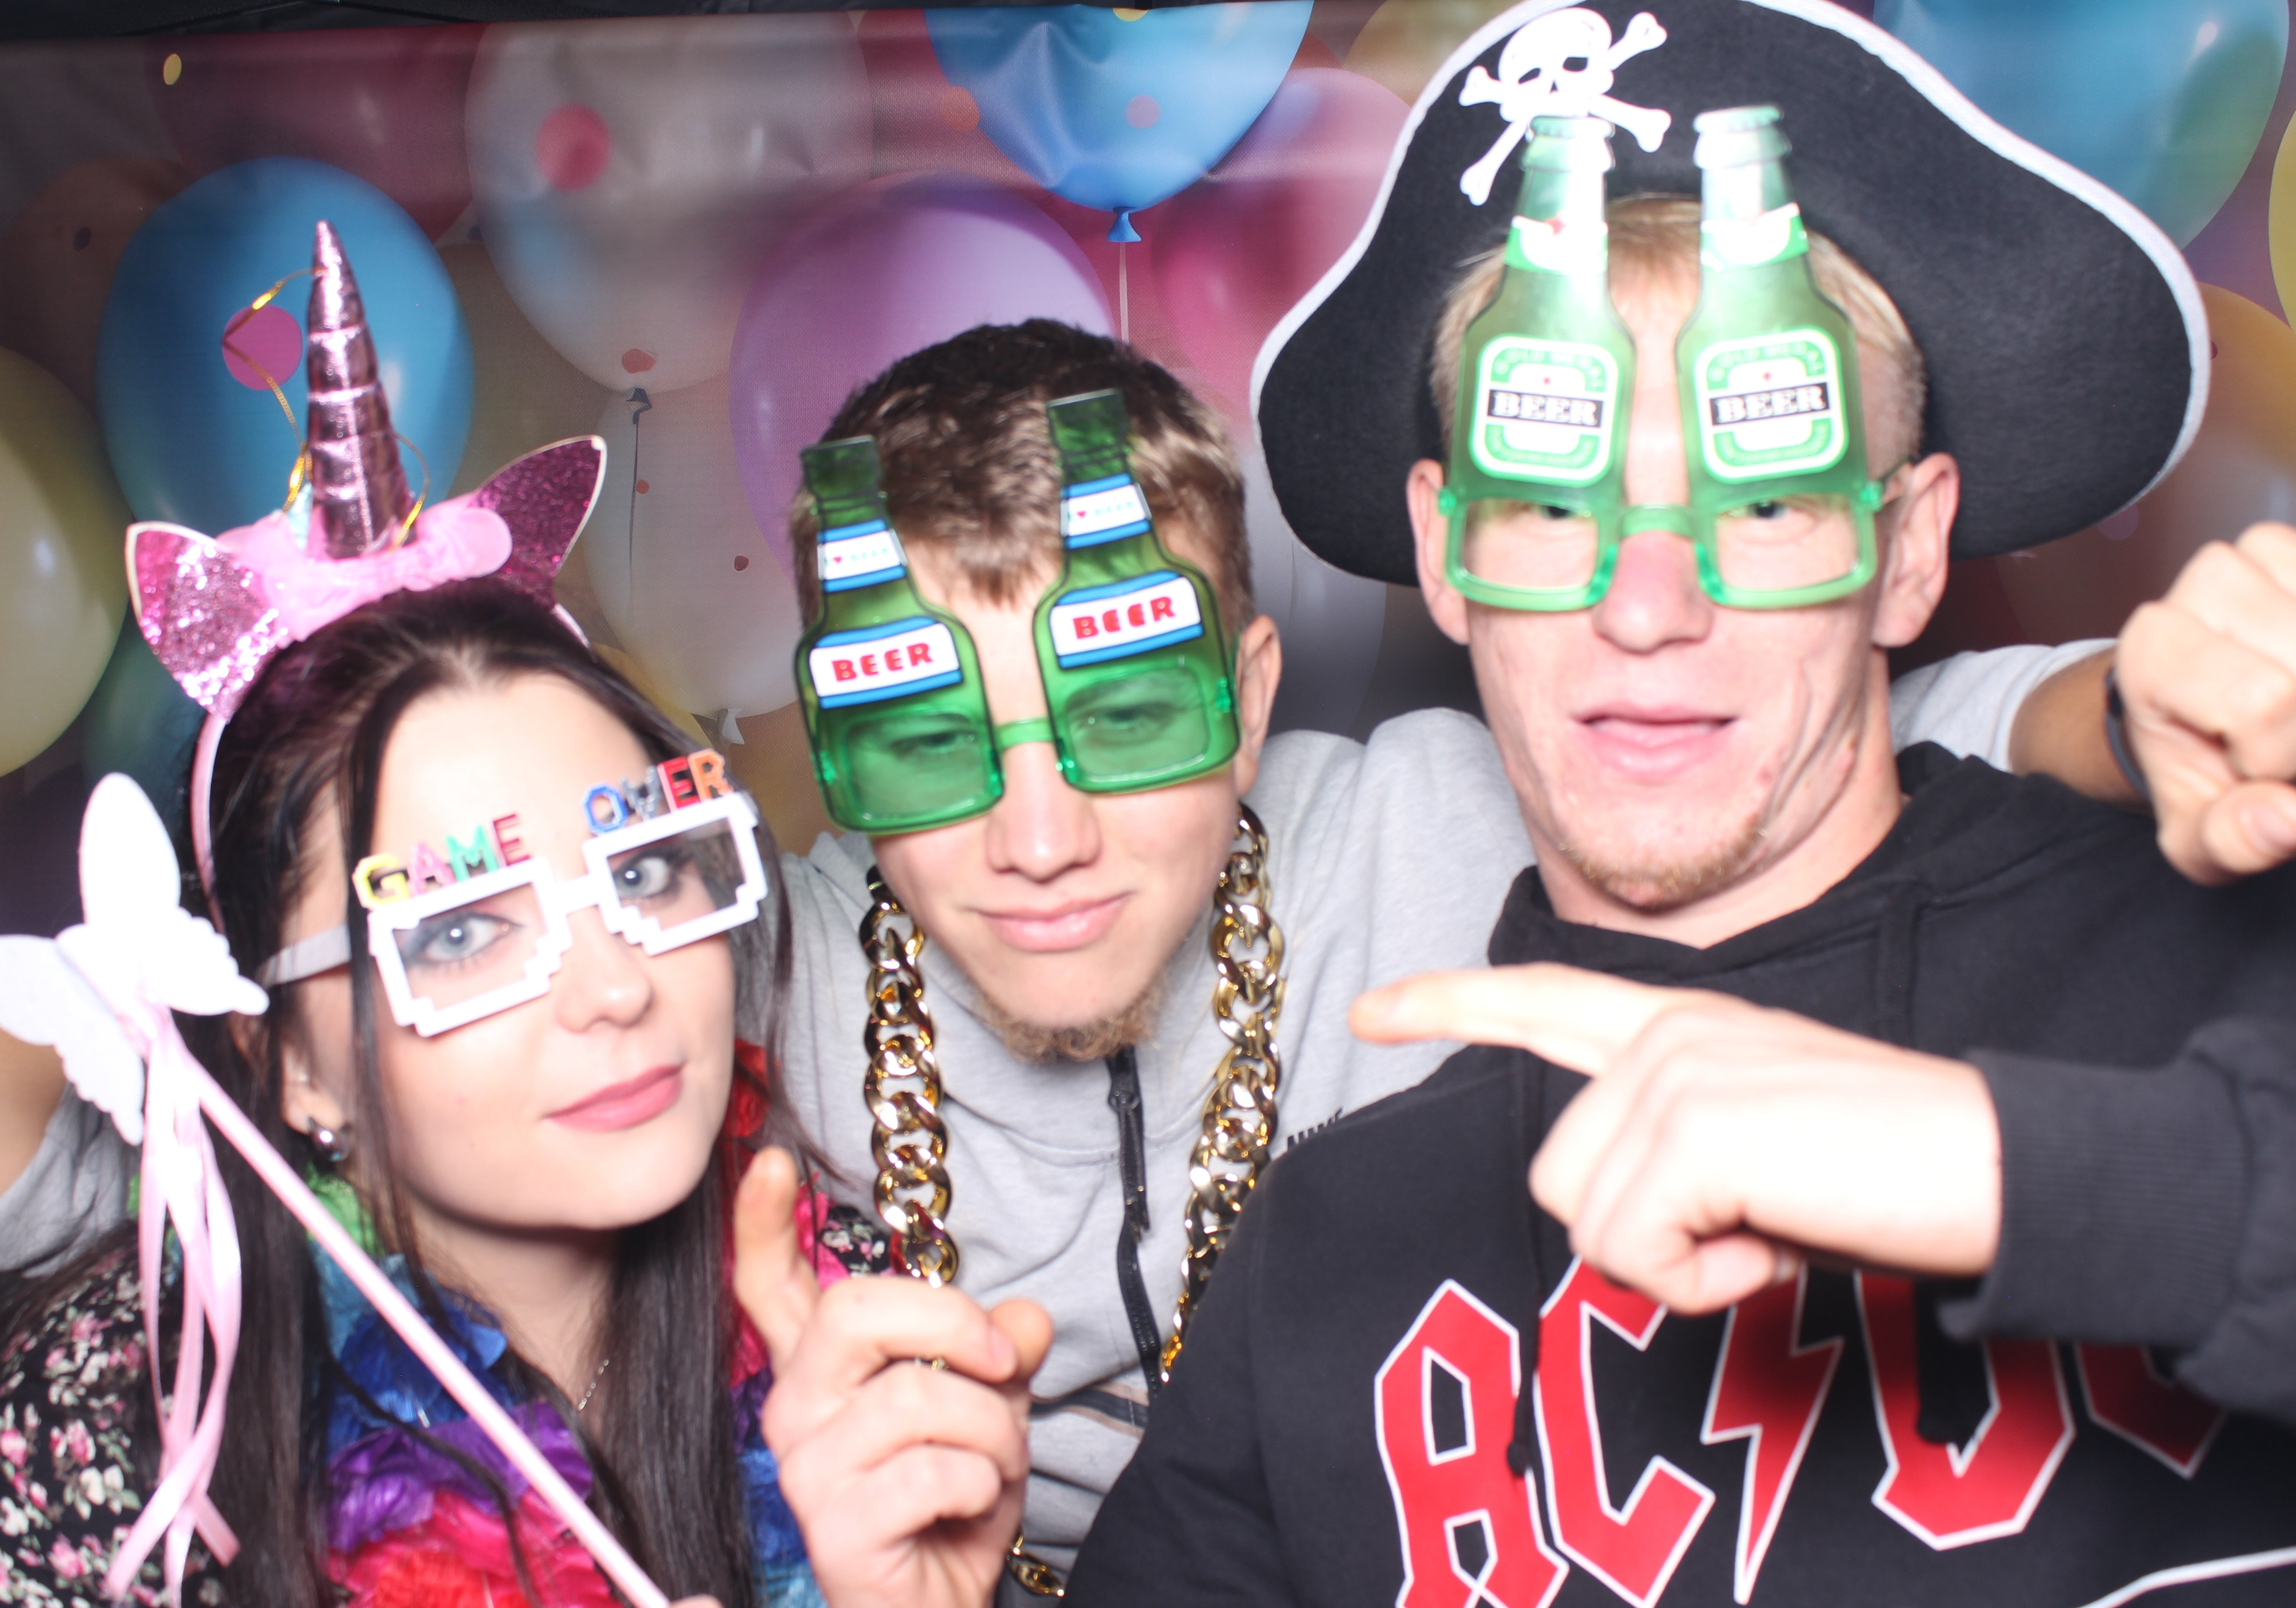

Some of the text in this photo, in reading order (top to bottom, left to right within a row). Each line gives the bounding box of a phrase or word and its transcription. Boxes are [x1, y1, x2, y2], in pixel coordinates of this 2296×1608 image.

[1491, 391, 1598, 426] BEER
[1715, 385, 1826, 424] BEER
[1073, 596, 1176, 640] BEER
[832, 642, 933, 682] BEER
[353, 748, 733, 909] GAME OVER
